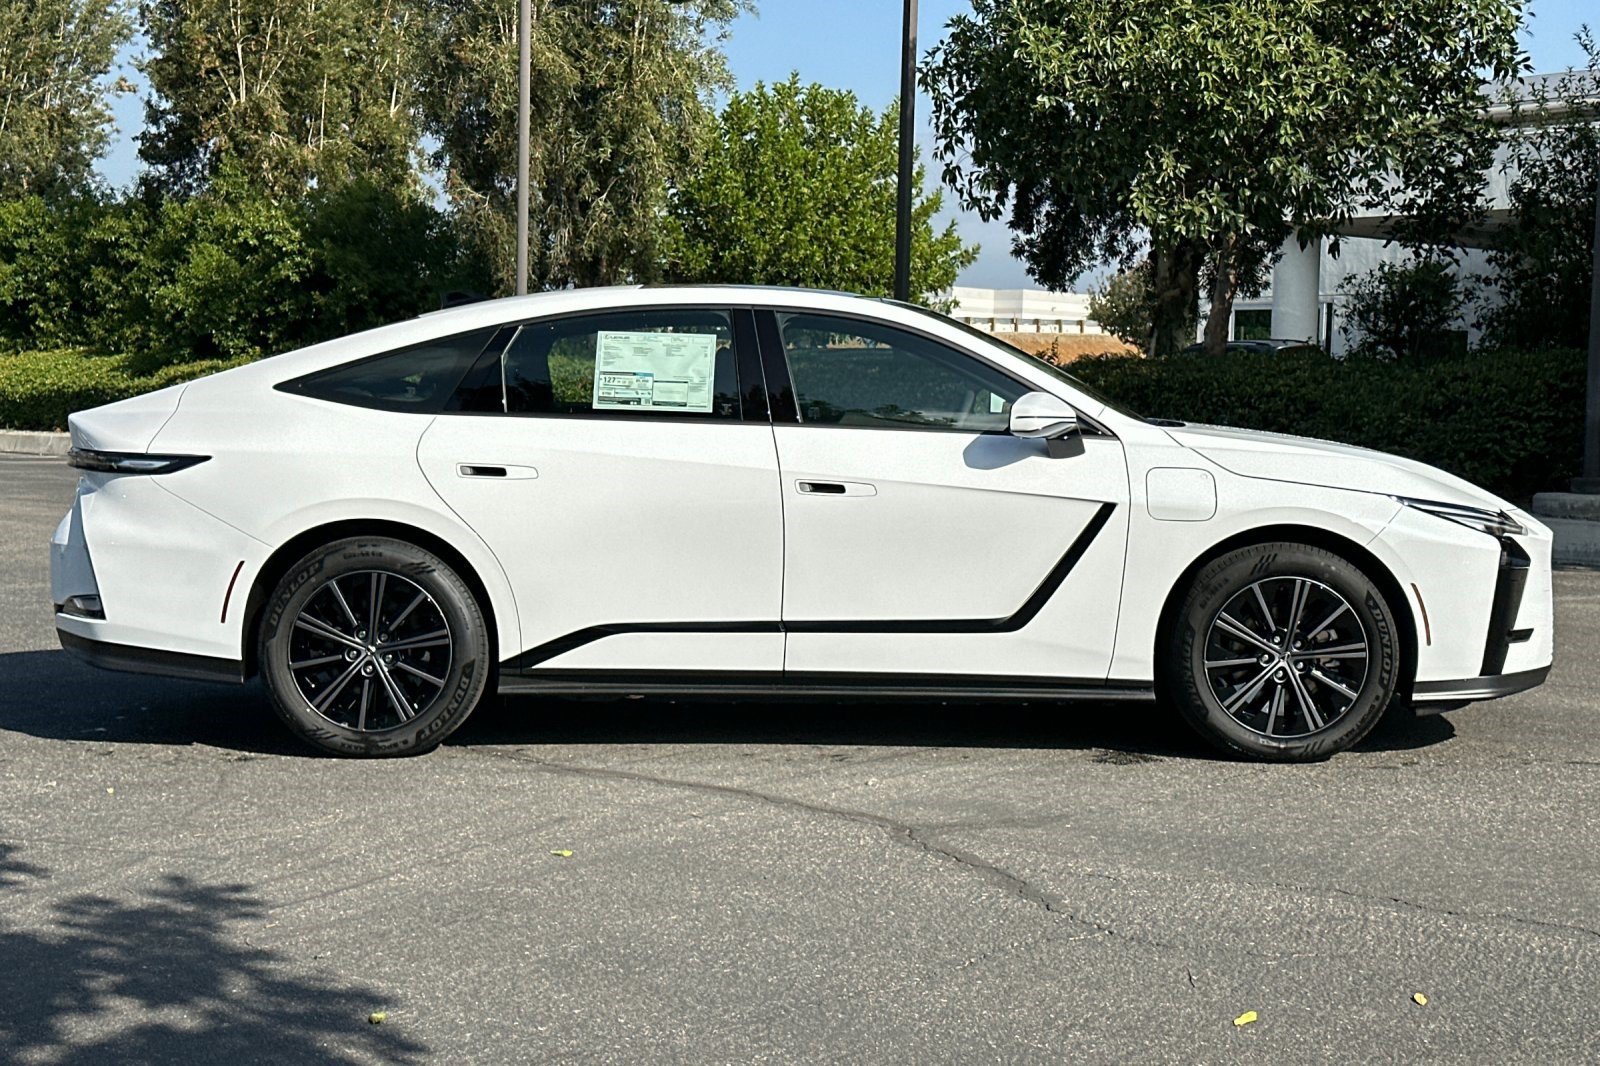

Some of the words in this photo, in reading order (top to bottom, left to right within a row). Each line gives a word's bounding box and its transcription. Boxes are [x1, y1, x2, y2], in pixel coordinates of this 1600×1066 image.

[270, 562, 320, 626] DUNLOP
[1182, 630, 1203, 706] DUNLOP
[1371, 608, 1392, 685] DUNLOP
[420, 675, 470, 740] DUNLOP
